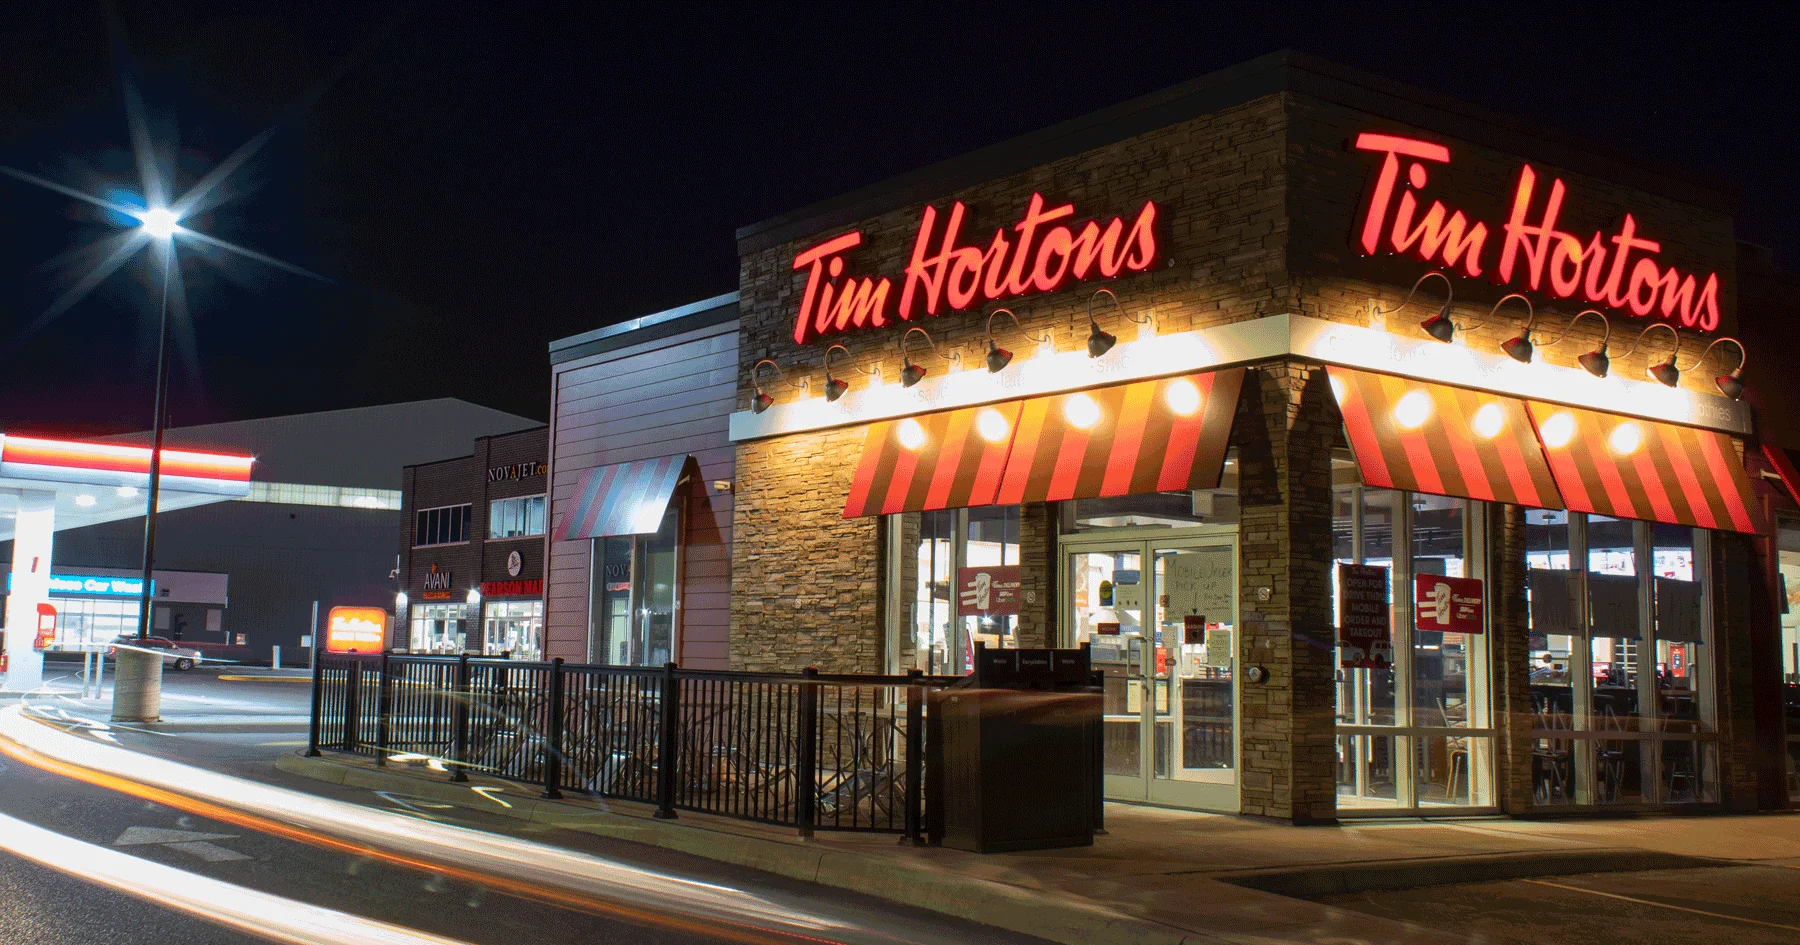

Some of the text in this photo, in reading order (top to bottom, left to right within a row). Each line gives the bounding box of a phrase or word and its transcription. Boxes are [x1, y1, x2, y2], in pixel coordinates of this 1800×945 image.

[1355, 133, 1719, 331] Tim Hortons
[793, 192, 1156, 345] Tim Hortons
[423, 572, 449, 589] AVANI
[1347, 579, 1367, 588] OPEN
[1351, 603, 1380, 613] MOBILE
[1344, 615, 1386, 625] ORDER AND
[1349, 628, 1382, 637] TAKEOUT
